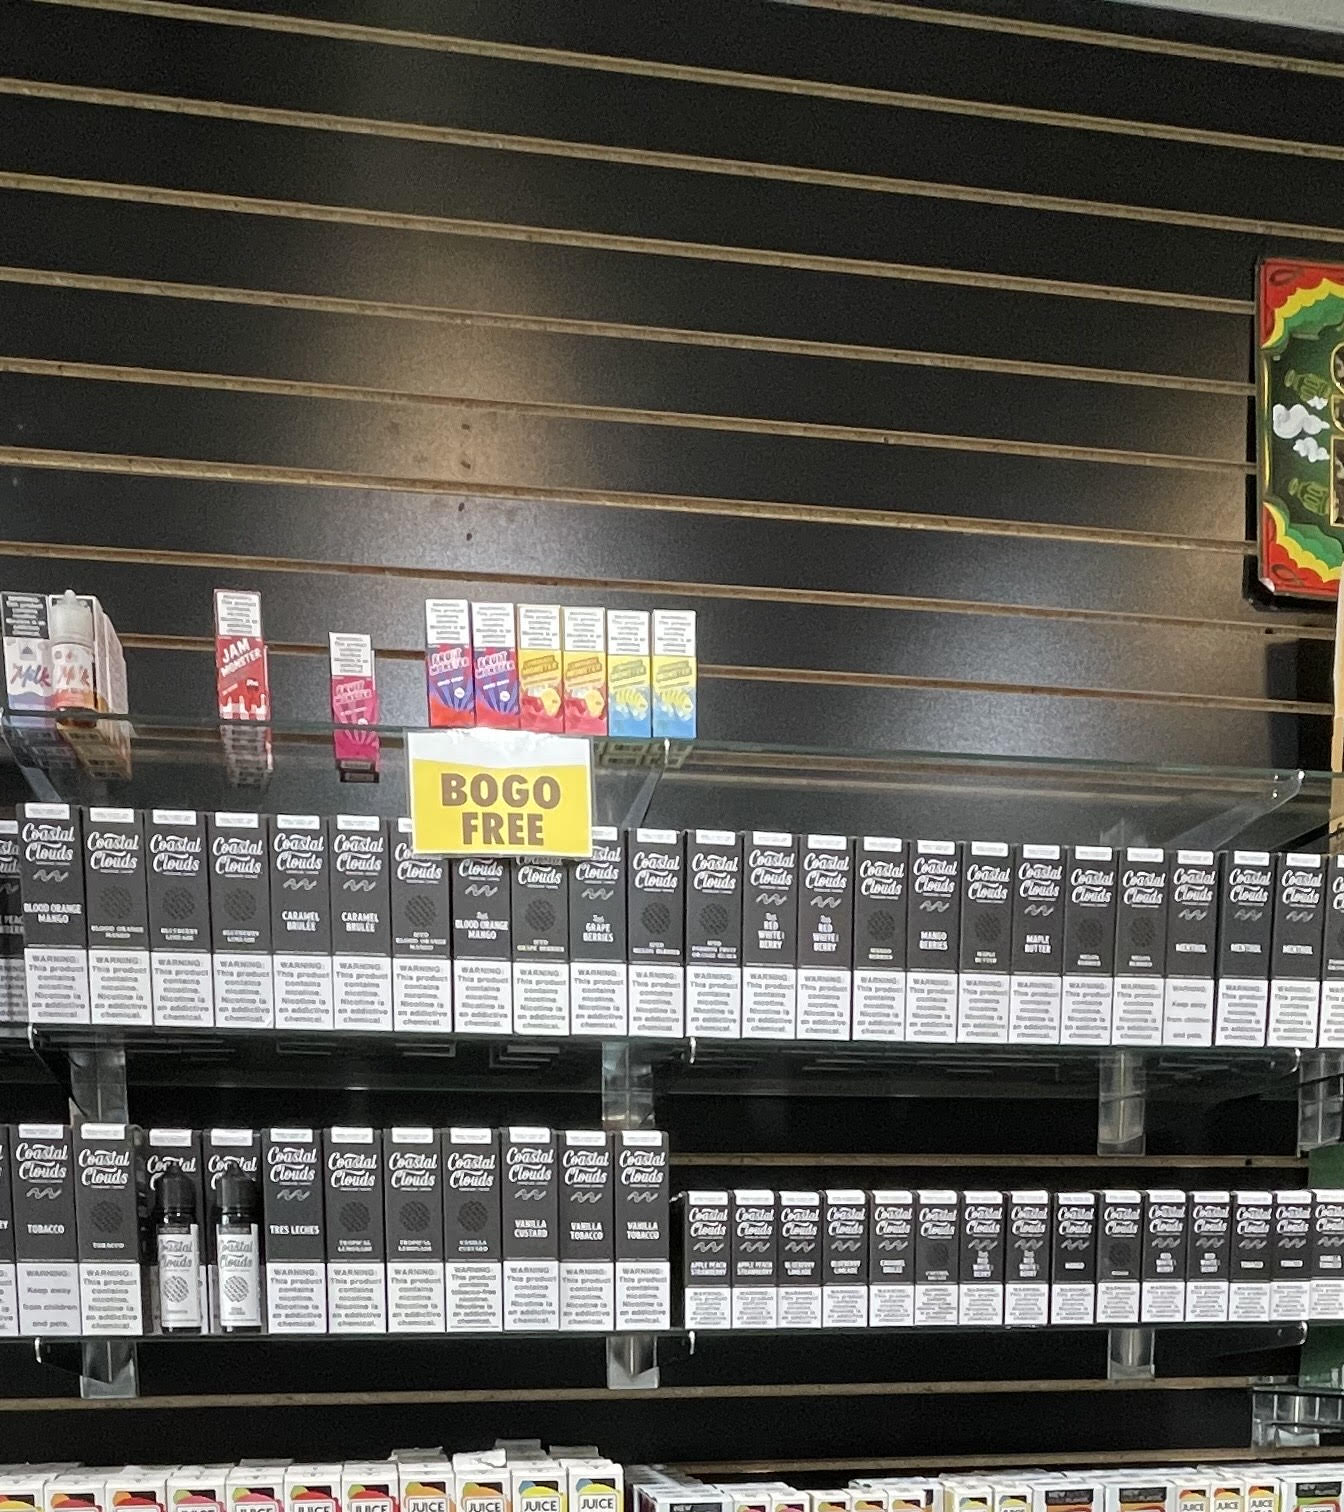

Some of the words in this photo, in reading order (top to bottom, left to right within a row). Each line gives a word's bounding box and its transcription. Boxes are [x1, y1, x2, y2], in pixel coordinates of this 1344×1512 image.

[222, 637, 250, 663] JAM
[440, 772, 561, 810] BOGO
[462, 810, 545, 847] FREE
[87, 832, 139, 851] Coastal
[273, 833, 324, 852] Coastal
[90, 850, 138, 870] Clouds
[276, 852, 323, 871] Clouds
[749, 849, 795, 868] Coastal
[751, 867, 792, 886] Clouds
[23, 903, 50, 913] BLOOD
[52, 903, 82, 914] ORANGE
[281, 911, 320, 921] CARAMEL
[582, 932, 614, 942] BERRIES
[586, 923, 611, 932] GRAPE
[389, 1151, 438, 1171] Coastal
[618, 1149, 665, 1168] Coastal
[391, 1170, 436, 1189] Clouds
[621, 1167, 664, 1185] Clouds
[27, 1224, 65, 1234] TOBACCO
[270, 1224, 289, 1235] TRES
[514, 1219, 547, 1229] VANILLA
[581, 1498, 614, 1509] JUICE
